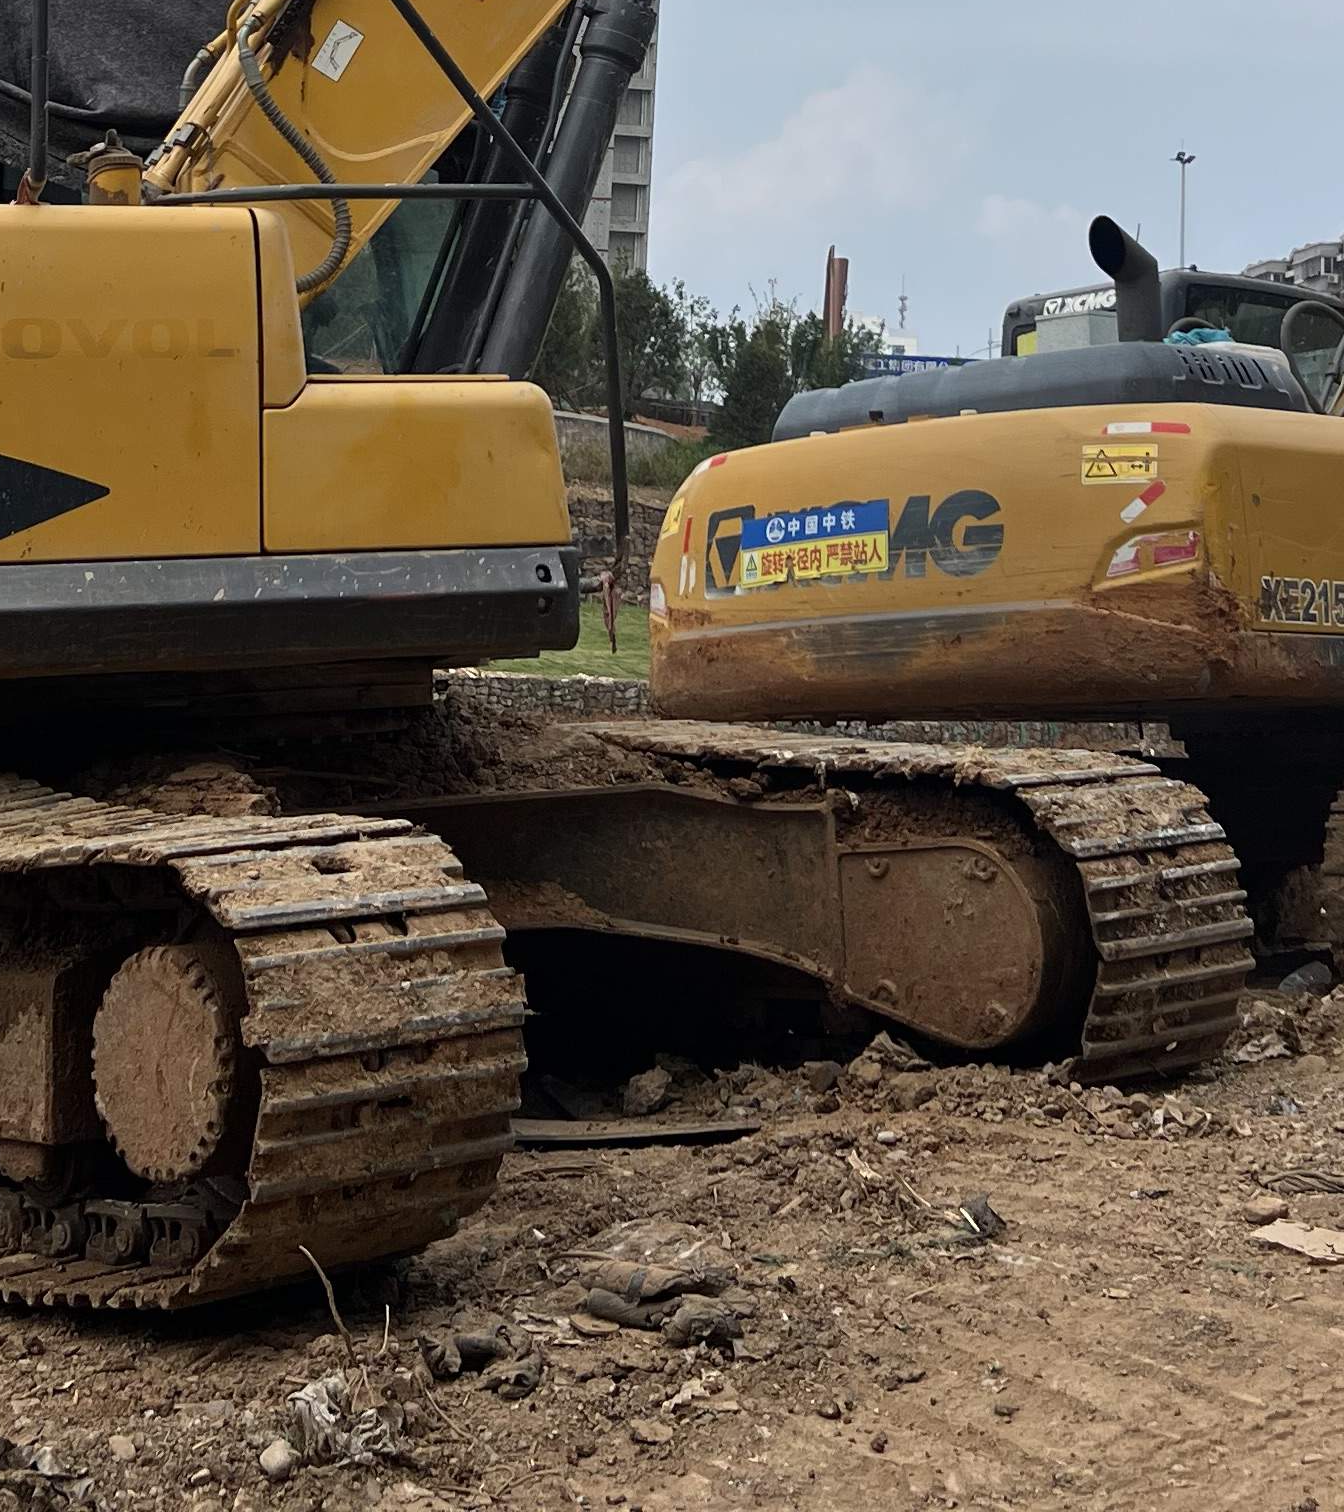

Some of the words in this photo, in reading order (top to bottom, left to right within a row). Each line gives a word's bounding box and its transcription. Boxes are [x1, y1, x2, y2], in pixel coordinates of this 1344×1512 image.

[1062, 289, 1117, 314] XCMG
[787, 511, 856, 537] 中国中铁
[826, 538, 882, 569] 严禁站人
